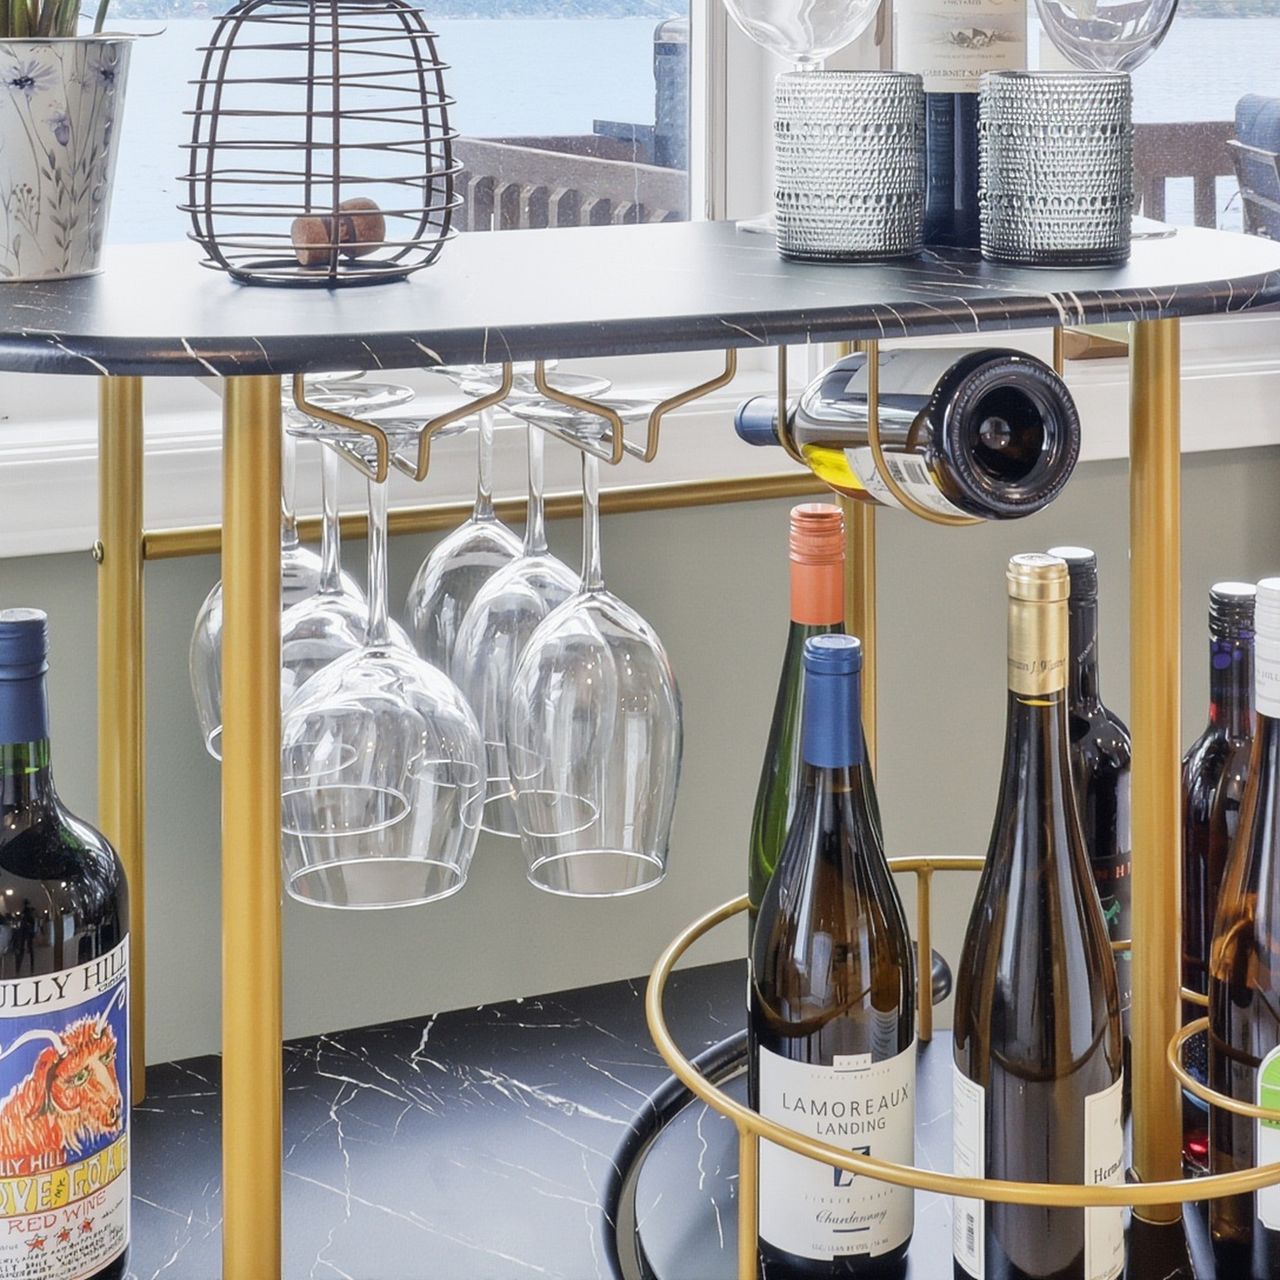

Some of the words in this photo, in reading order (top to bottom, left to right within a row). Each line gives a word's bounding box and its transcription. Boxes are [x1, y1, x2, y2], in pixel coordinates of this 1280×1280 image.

[782, 1083, 909, 1119] LAMOREAUX
[816, 1117, 887, 1136] LANDING
[30, 1149, 66, 1175] HILL
[7, 1213, 58, 1235] RED
[62, 1190, 108, 1223] WINE
